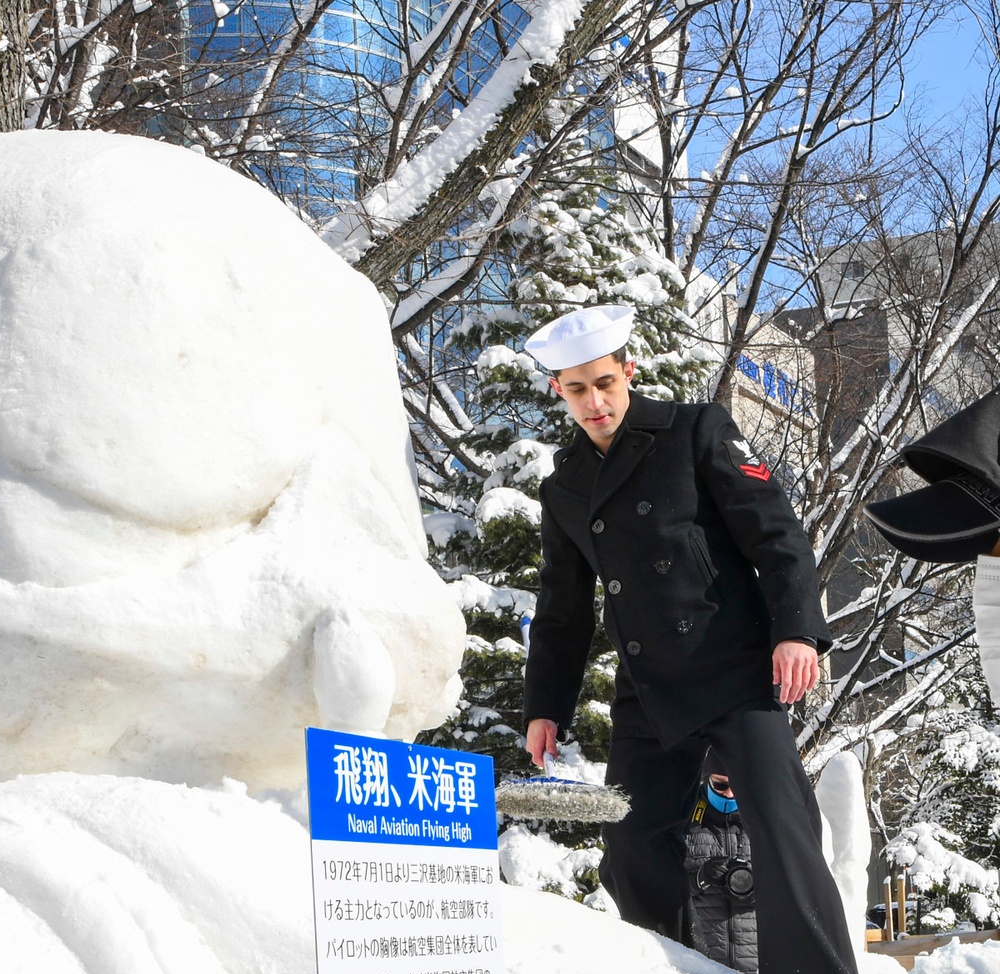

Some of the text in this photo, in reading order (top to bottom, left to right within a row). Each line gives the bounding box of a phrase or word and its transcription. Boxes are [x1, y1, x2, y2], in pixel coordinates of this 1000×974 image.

[333, 744, 479, 815] 飛翔、米海軍
[347, 813, 473, 843] Naval Aviation Flying High
[322, 860, 494, 885] 1972年7月1日より三沢基地の米海軍にお
[323, 899, 494, 921] ける主力となっているのが、航空部隊です。
[326, 934, 498, 960] パイロットの胸像は航空集団全体を表してい
